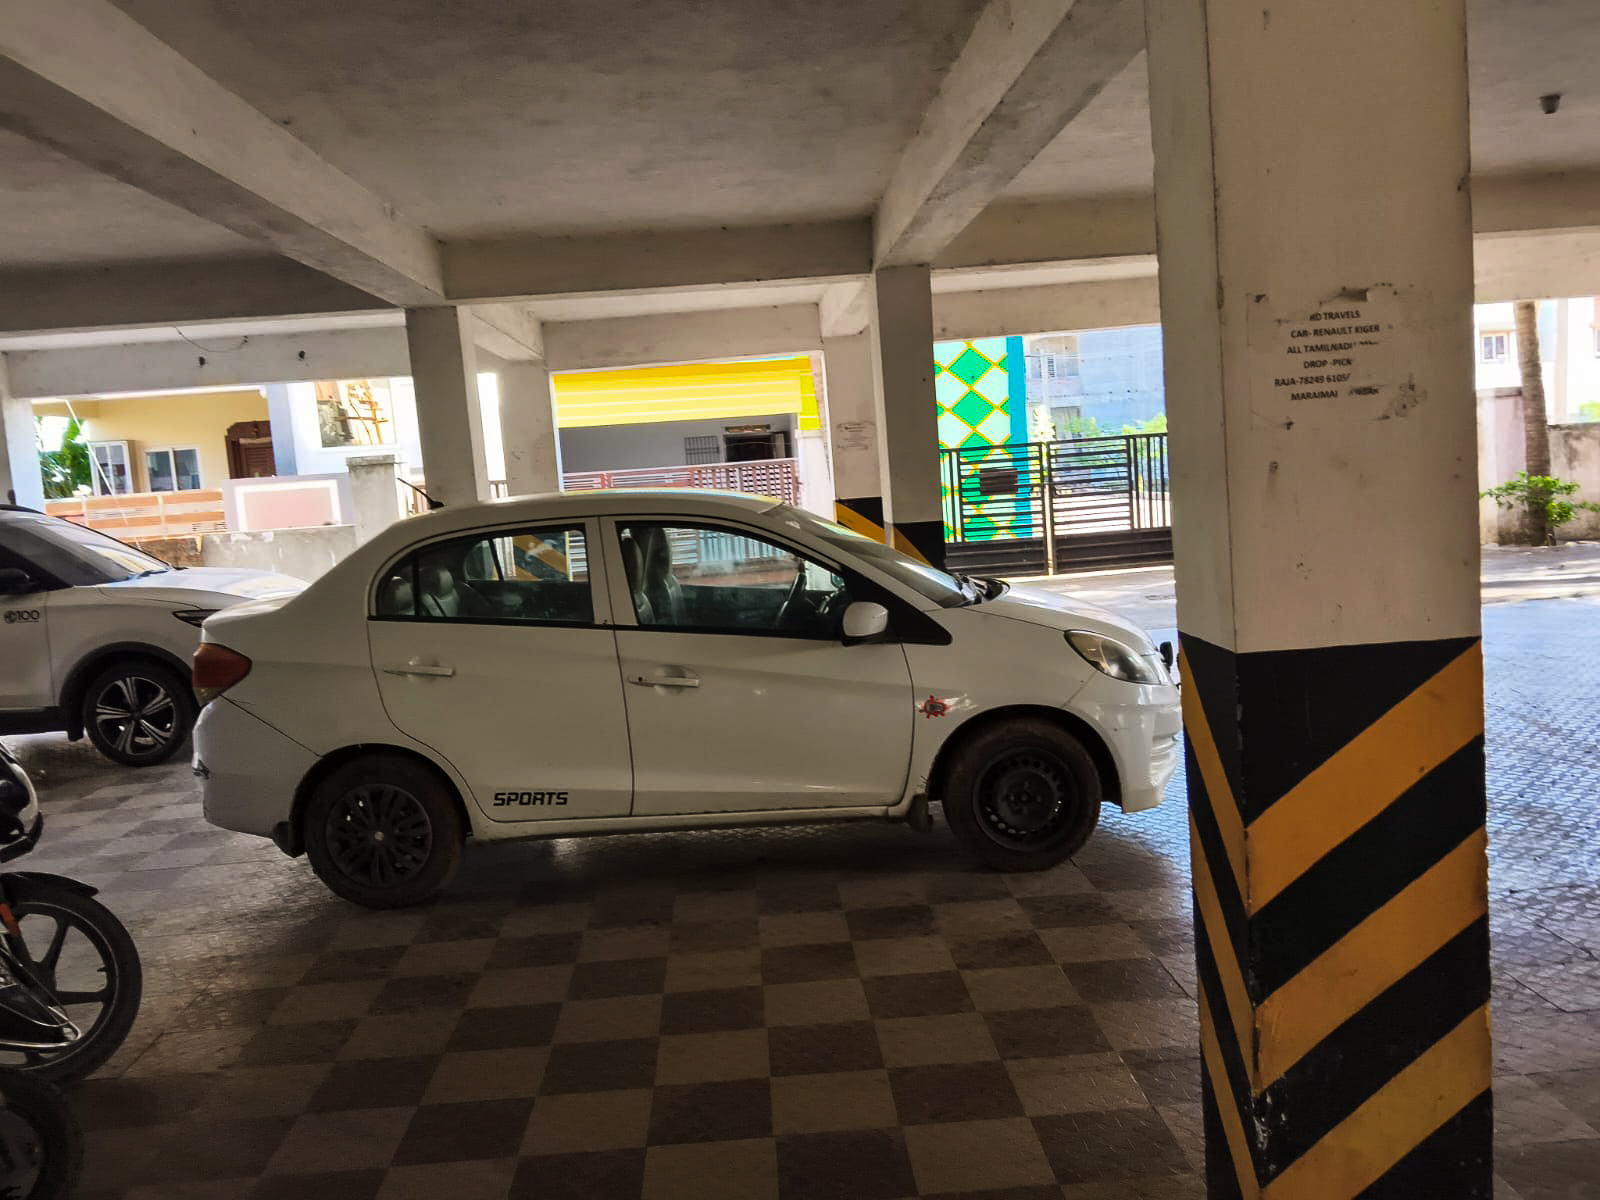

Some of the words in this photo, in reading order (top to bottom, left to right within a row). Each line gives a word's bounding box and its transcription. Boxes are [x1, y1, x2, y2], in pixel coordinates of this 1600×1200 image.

[1324, 310, 1361, 320] TRAVELS
[1290, 330, 1312, 338] CAR-
[1313, 327, 1353, 337] RENAULT
[1354, 324, 1380, 334] KIGER
[1287, 345, 1302, 354] ALL
[1303, 359, 1328, 369] DROP
[493, 791, 569, 806] SPORTS
